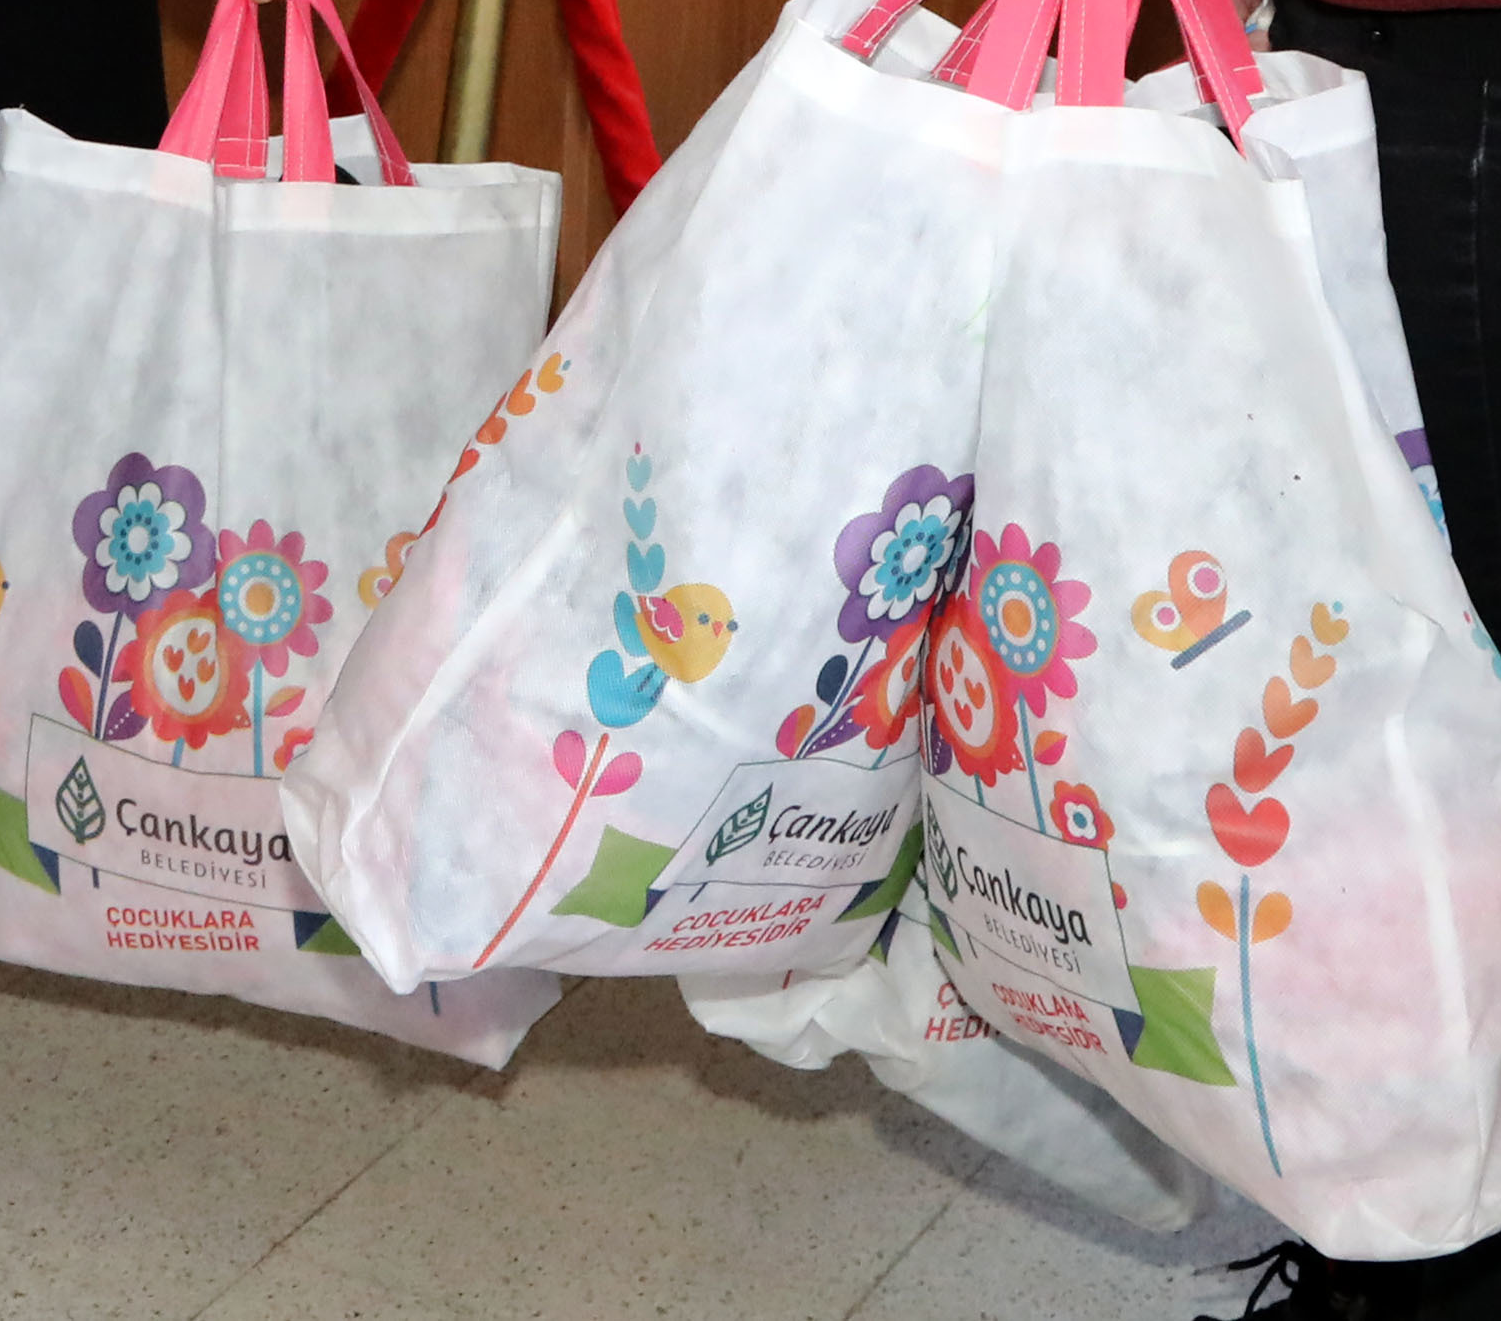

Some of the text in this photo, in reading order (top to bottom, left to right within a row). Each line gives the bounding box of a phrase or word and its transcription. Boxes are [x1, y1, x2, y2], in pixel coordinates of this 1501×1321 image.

[116, 797, 294, 865] Çankaya
[768, 803, 900, 847] Çankaya
[139, 847, 269, 890] BELEDİYESİ
[106, 906, 256, 931] ÇOCUKLARA
[956, 846, 1094, 948] Çankaya
[106, 931, 261, 953] HEDİYESİDİR
[644, 916, 812, 952] HEDİYESİDİR
[983, 913, 1082, 975] BELEDİYESİ
